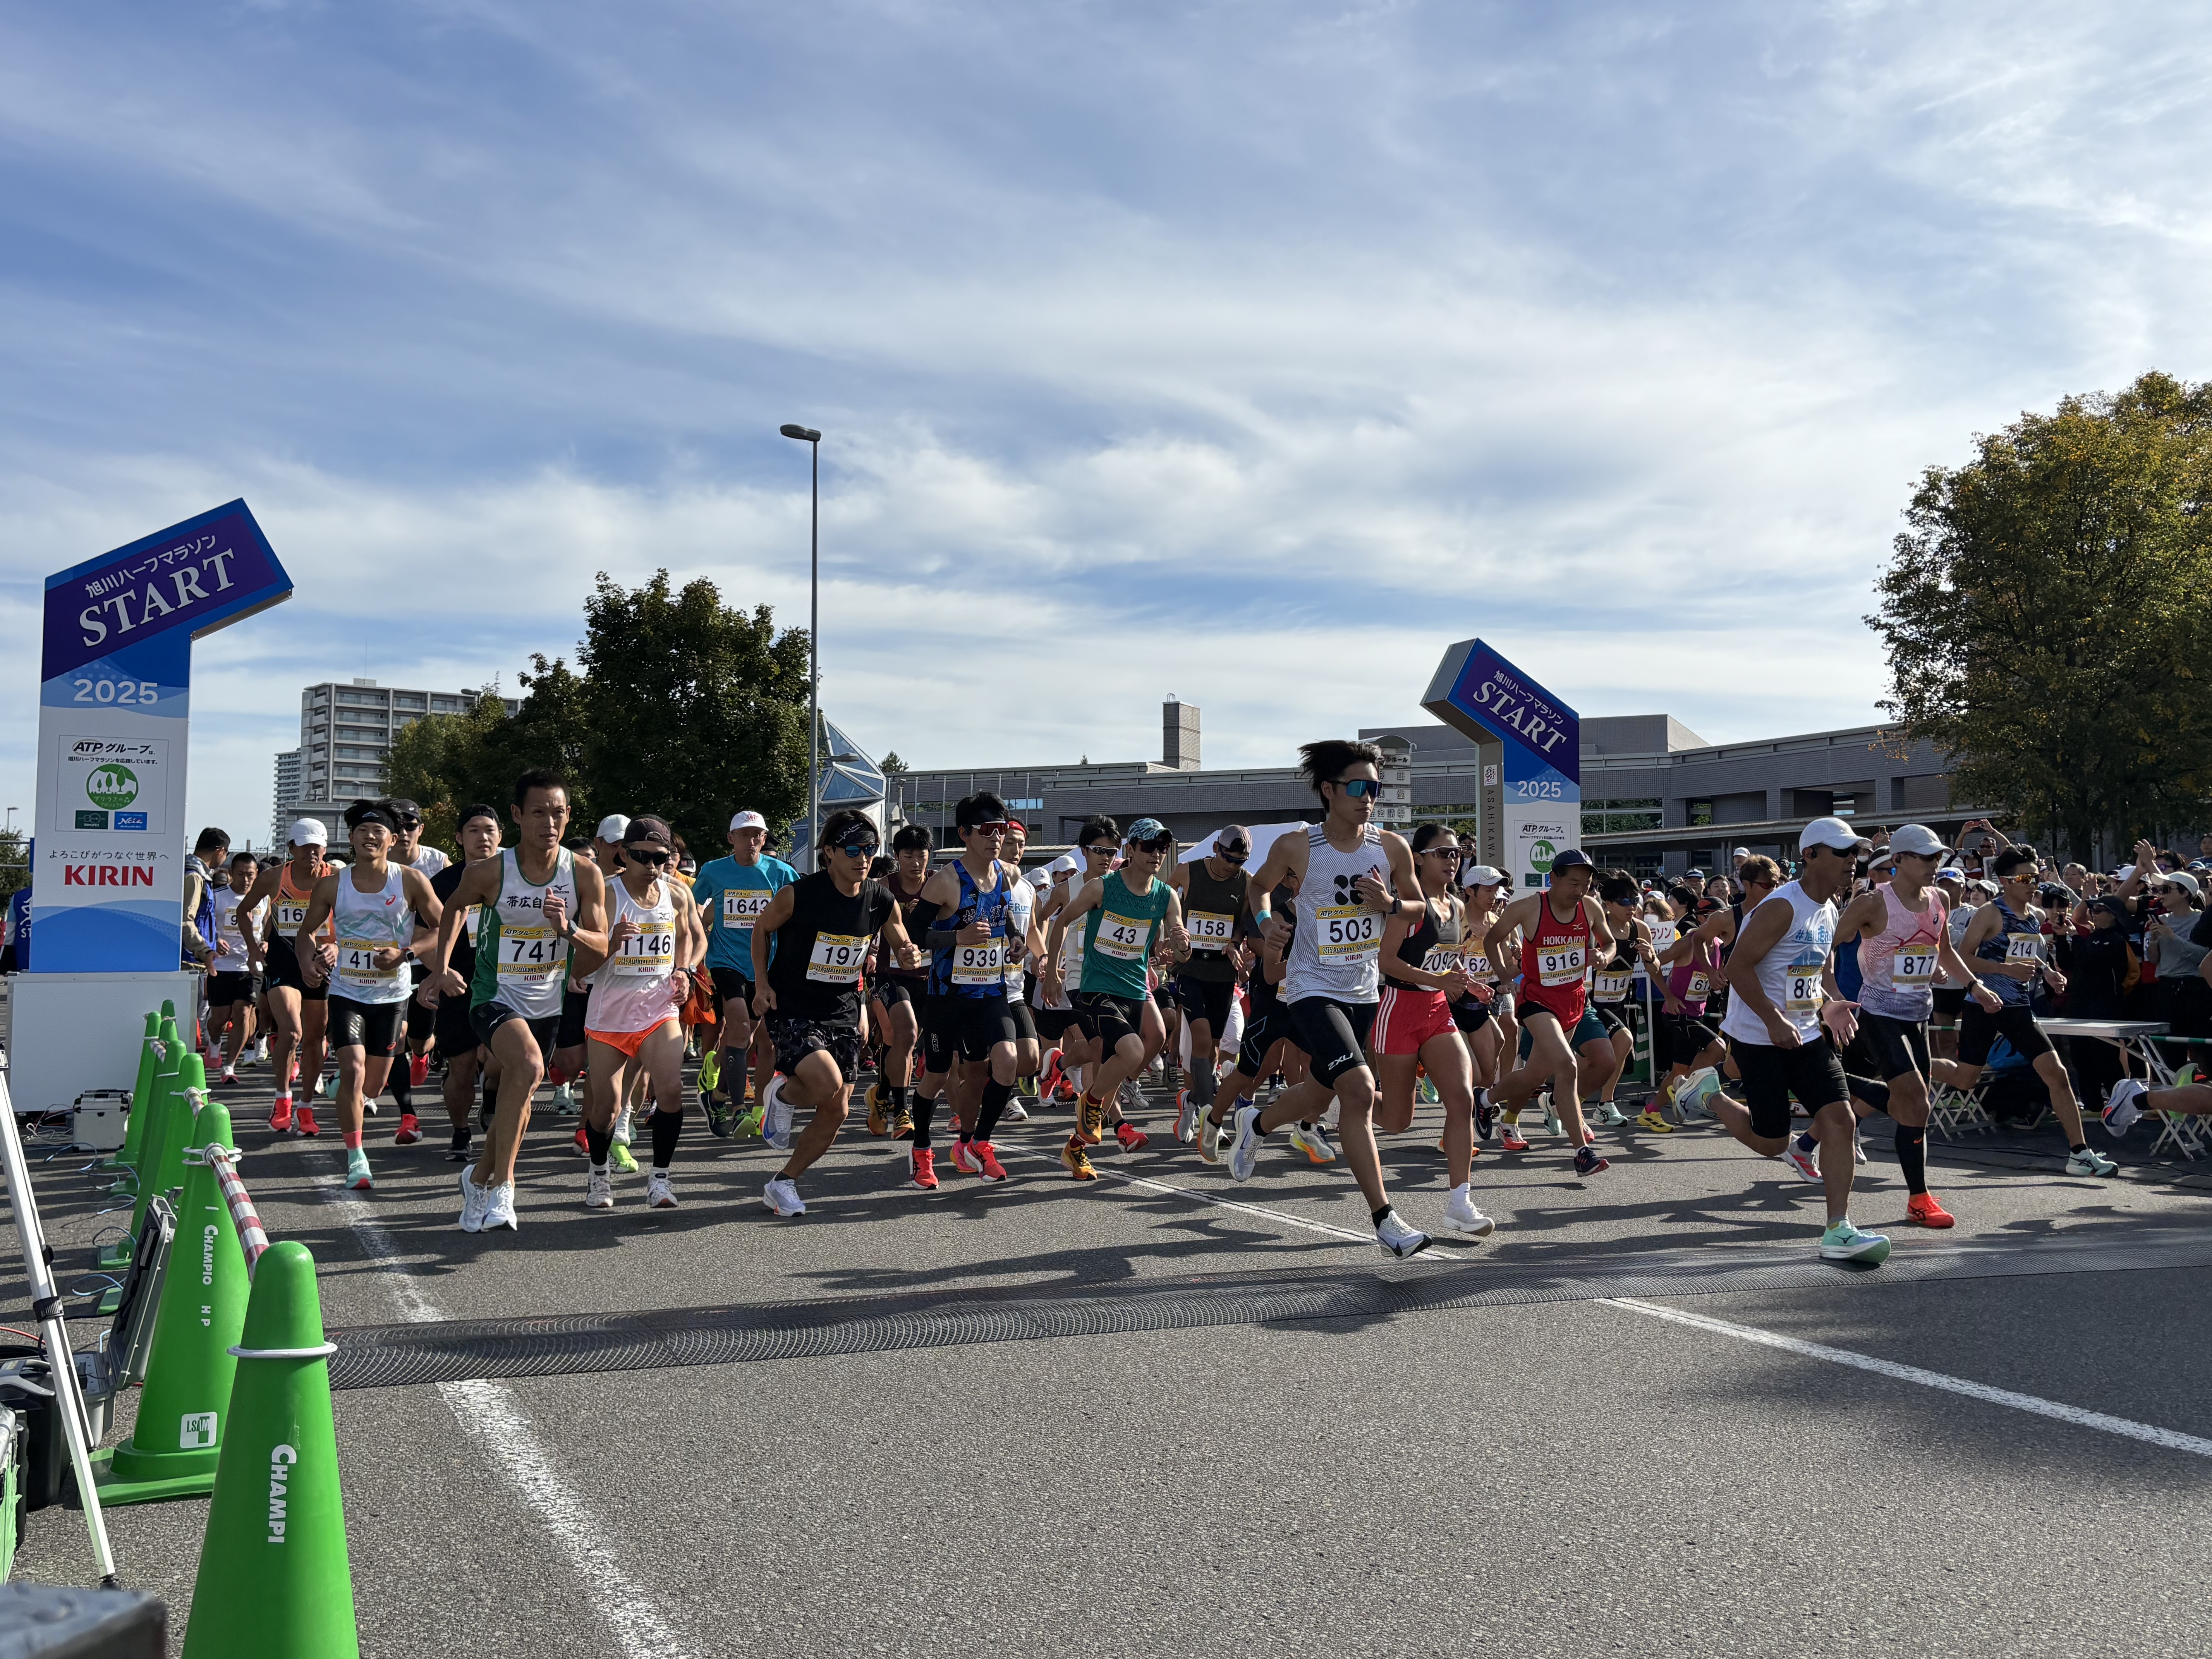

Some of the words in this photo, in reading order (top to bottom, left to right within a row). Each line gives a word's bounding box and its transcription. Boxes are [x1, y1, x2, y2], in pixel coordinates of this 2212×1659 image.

[85, 534, 216, 598] 旭川ハーフマラソン
[79, 548, 235, 647] START
[73, 678, 158, 705] 2025
[1493, 670, 1564, 725] 旭川ハーフマラソン
[1473, 681, 1567, 754] START
[1517, 780, 1561, 798] 2025
[1487, 790, 1495, 858] ASAHIKAWA
[49, 849, 169, 861] よろこびがつなぐ世界へ
[64, 864, 154, 886] KIRIN
[282, 908, 303, 922] 16
[1113, 926, 1137, 944] 43
[1195, 920, 1225, 936] 158
[1329, 917, 1372, 943] 503
[512, 939, 556, 963] 741
[624, 935, 671, 955] 1146
[2011, 941, 2032, 957] 214
[350, 951, 371, 970] 41
[825, 946, 863, 966] 197
[963, 949, 997, 967] 939
[1345, 953, 1363, 962] KIRIN
[1422, 951, 1458, 971] 2092
[1546, 951, 1579, 971] 916
[1903, 955, 1935, 975] 877
[1603, 977, 1626, 991] 114
[1794, 976, 1817, 999] 884
[1327, 1052, 1353, 1071] 2XU
